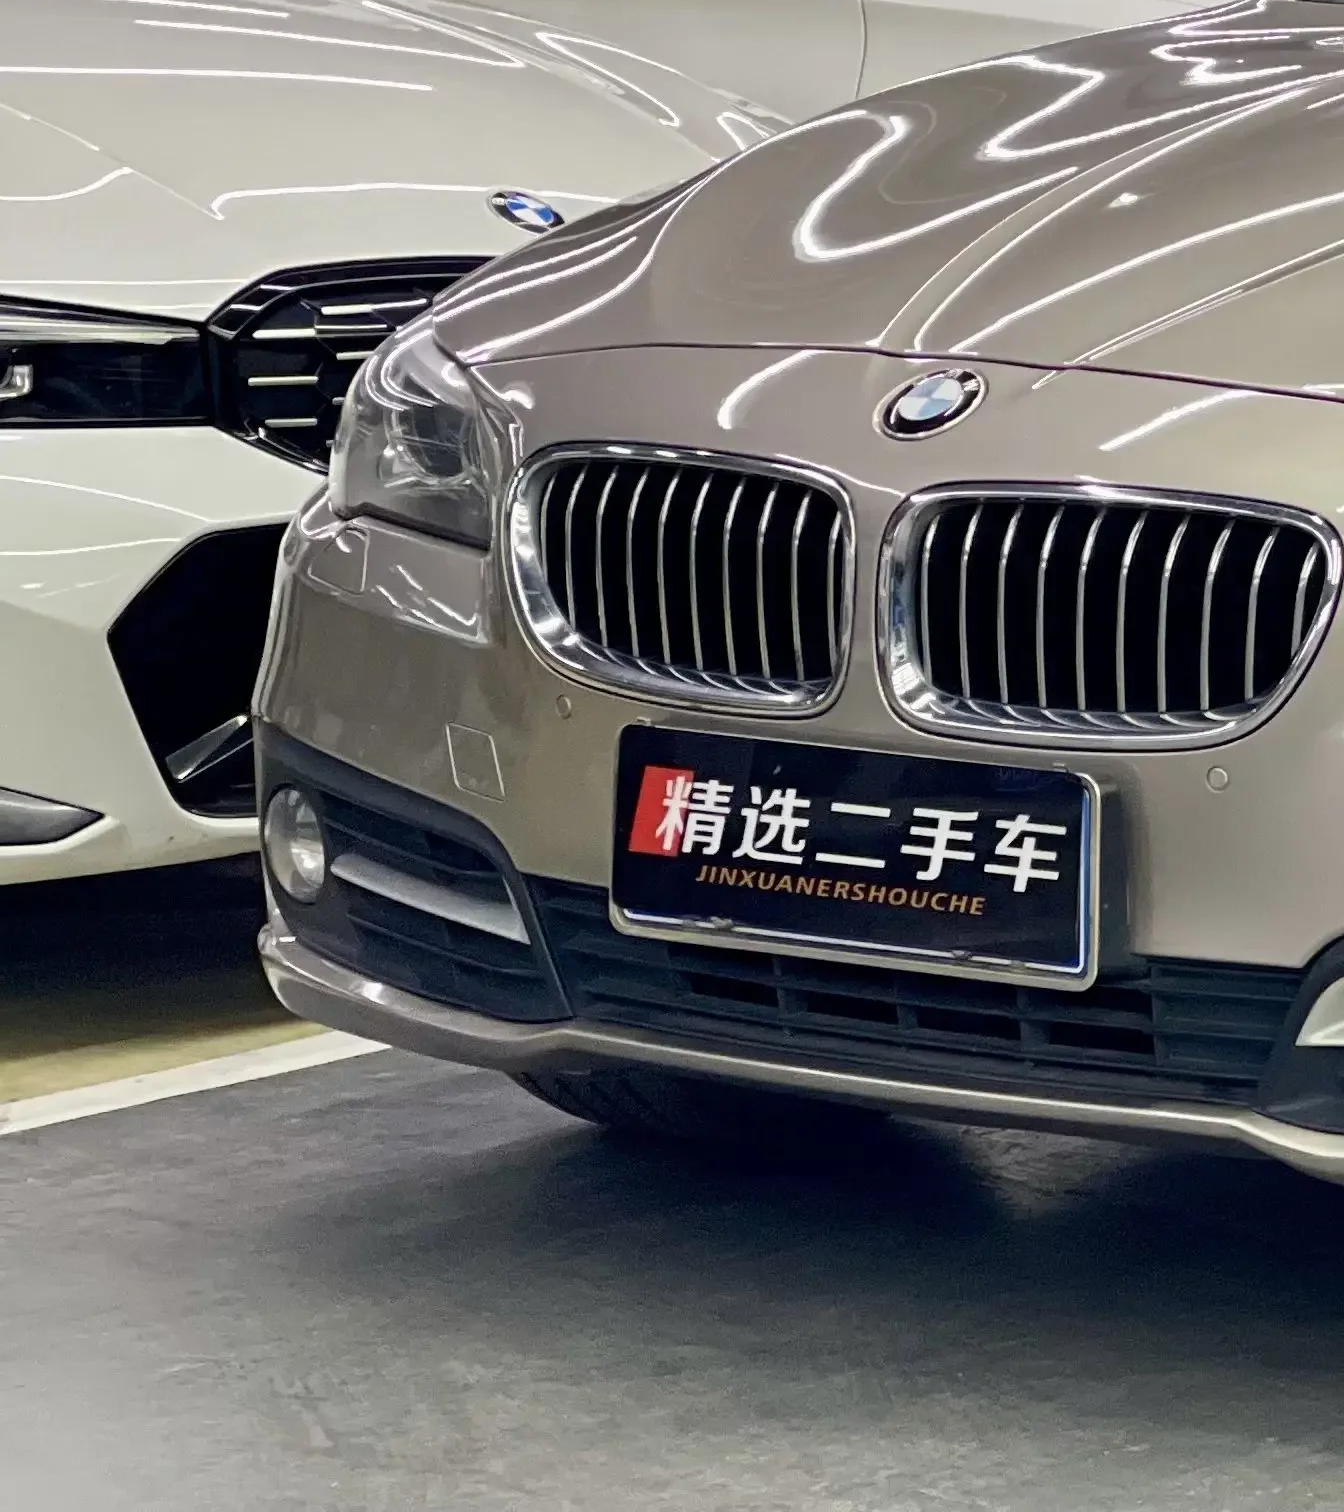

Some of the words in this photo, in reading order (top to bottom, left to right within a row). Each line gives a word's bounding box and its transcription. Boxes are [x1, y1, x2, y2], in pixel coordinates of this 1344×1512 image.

[654, 775, 1068, 893] 精选二手车
[695, 865, 987, 916] JINXUANERSHOUCHE
